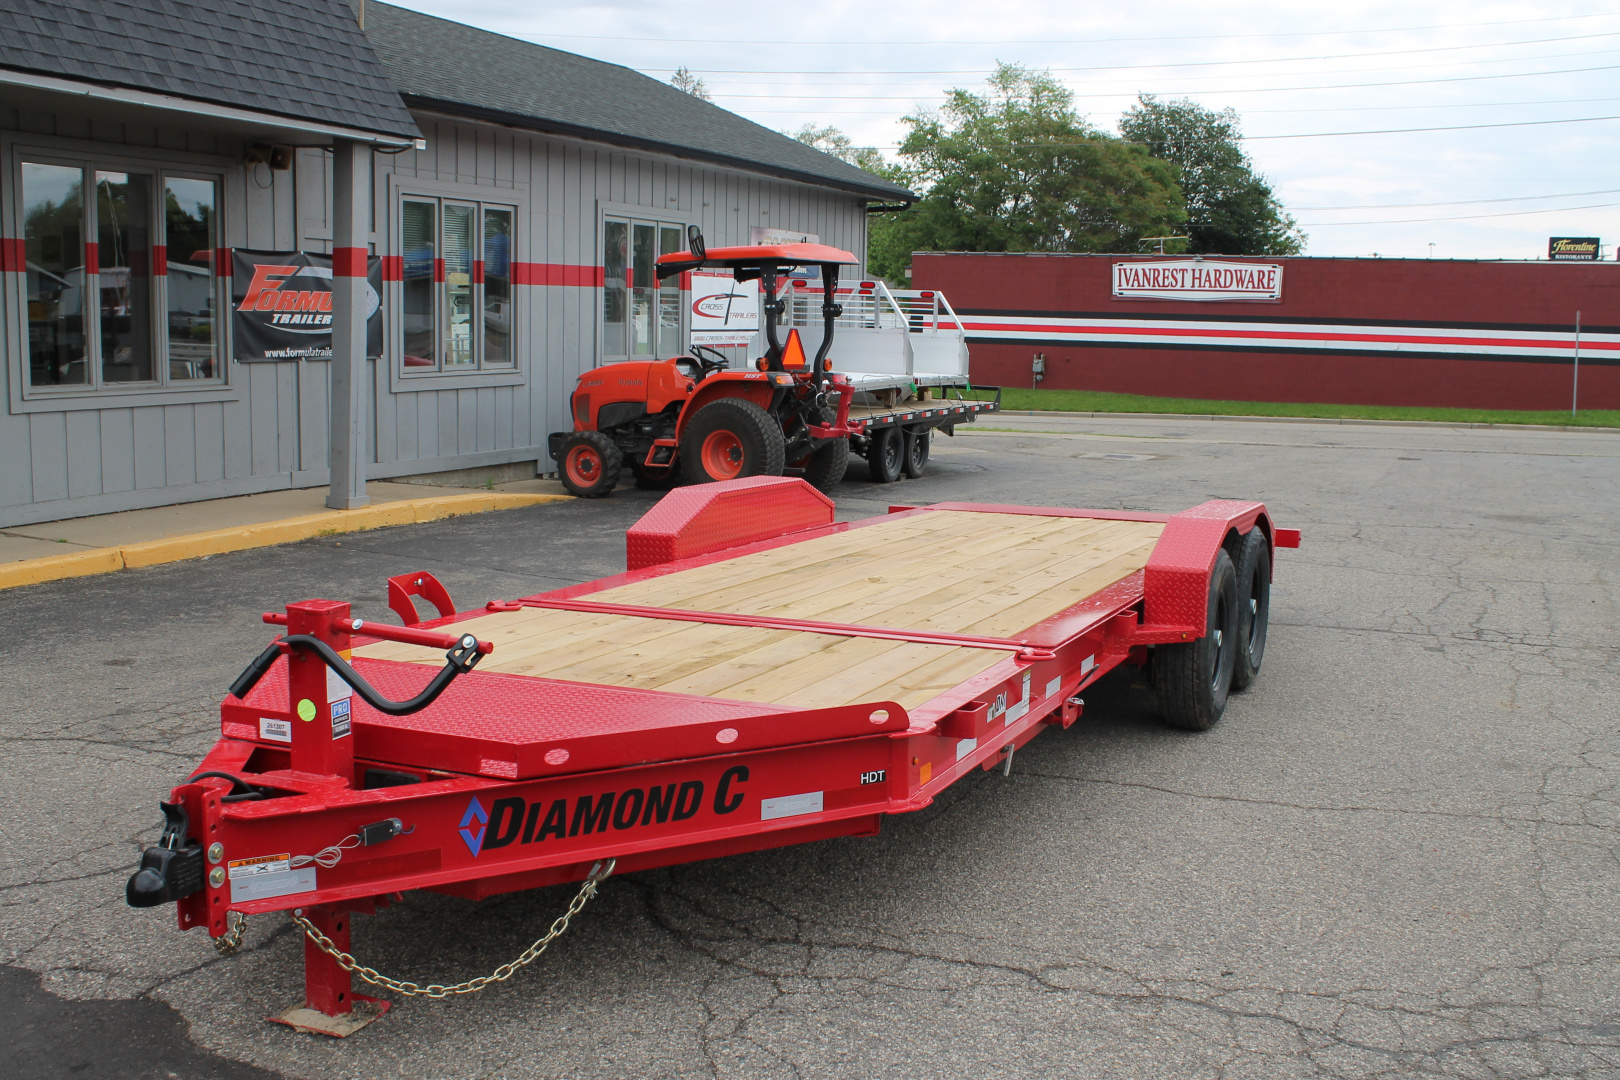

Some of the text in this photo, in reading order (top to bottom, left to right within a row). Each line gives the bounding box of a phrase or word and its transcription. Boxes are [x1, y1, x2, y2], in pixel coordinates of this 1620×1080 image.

[1551, 239, 1597, 254] Florentine
[1117, 268, 1276, 290] IVANREST HARDWARE
[237, 264, 332, 312] FORMU
[700, 303, 724, 311] CROSS
[272, 313, 332, 325] TRAILER
[265, 346, 332, 358] www.formulatraile
[333, 702, 348, 716] PRO
[860, 769, 886, 785] HDT
[482, 765, 750, 851] DIAMOND C
[245, 856, 280, 865] WARNING
